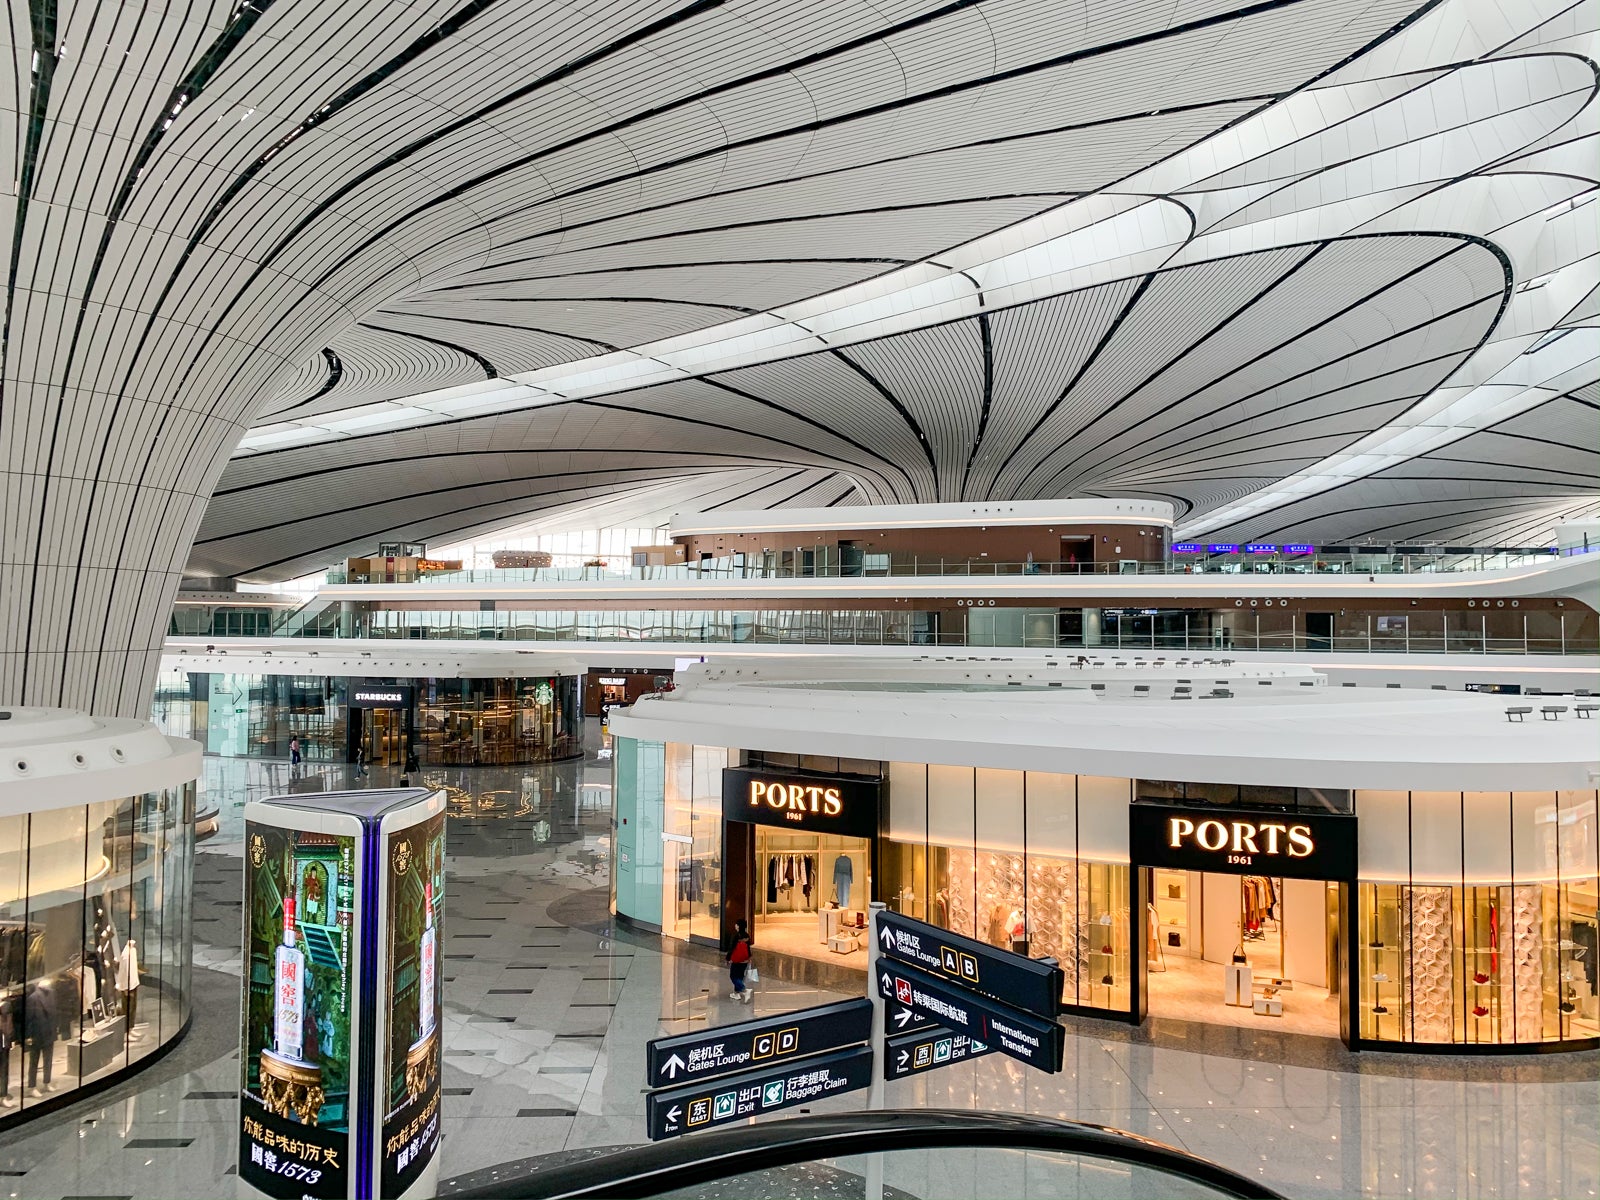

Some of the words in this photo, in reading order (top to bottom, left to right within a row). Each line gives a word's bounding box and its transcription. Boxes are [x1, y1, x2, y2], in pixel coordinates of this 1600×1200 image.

[355, 693, 402, 702] STARBUCKS
[750, 780, 842, 815] PORTS
[786, 812, 802, 821] 1961
[1170, 818, 1314, 857] PORTS
[1228, 855, 1252, 865] 1961
[895, 929, 921, 949] 候机区
[896, 943, 916, 958] Gates
[916, 948, 941, 967] Lounge
[946, 953, 955, 968] A
[964, 961, 974, 976] B
[913, 989, 968, 1026] 转乘国际航班
[991, 1019, 1039, 1048] International
[687, 1060, 715, 1073] Gates
[717, 1052, 750, 1067] Lounge
[758, 1039, 770, 1054] C
[782, 1033, 794, 1048] D
[688, 1043, 725, 1064] 候机区
[918, 1048, 929, 1059] 西
[952, 1048, 966, 1059] Exit
[1000, 1035, 1032, 1058] Transfer
[915, 1057, 930, 1066] WEST
[785, 1084, 822, 1100] Baggage
[824, 1076, 847, 1091] Claim
[786, 1069, 830, 1091] 行李提取
[738, 1086, 761, 1102] 出口
[691, 1113, 707, 1123] EAST
[693, 1102, 706, 1117] 东
[738, 1102, 754, 1114] Exit
[243, 1115, 340, 1169] 你能品味的历史
